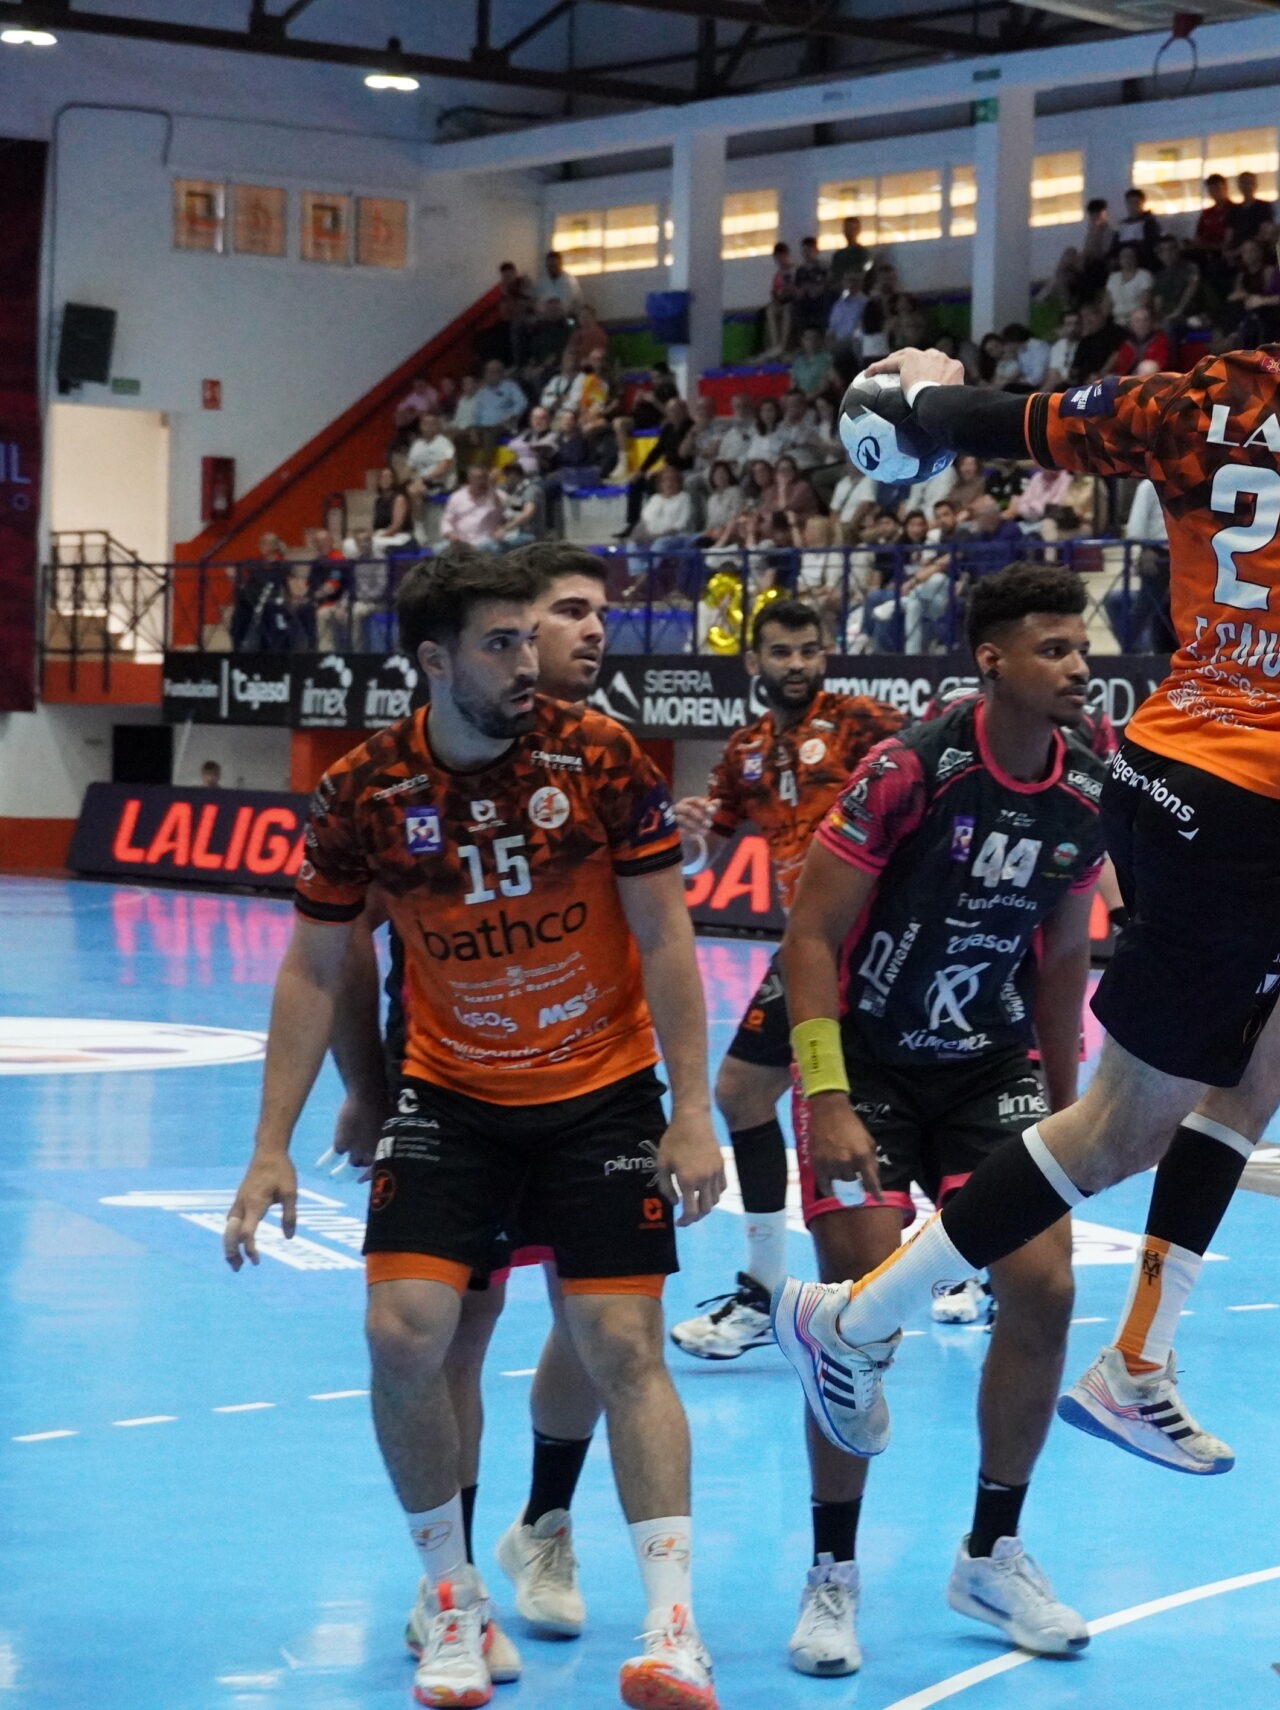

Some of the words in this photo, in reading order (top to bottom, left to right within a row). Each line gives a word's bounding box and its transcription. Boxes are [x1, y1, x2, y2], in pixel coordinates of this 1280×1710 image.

[643, 697, 747, 727] MORENA
[778, 769, 798, 807] 4
[457, 834, 532, 905] 15
[971, 831, 1043, 888] 44
[416, 902, 588, 962] bathco
